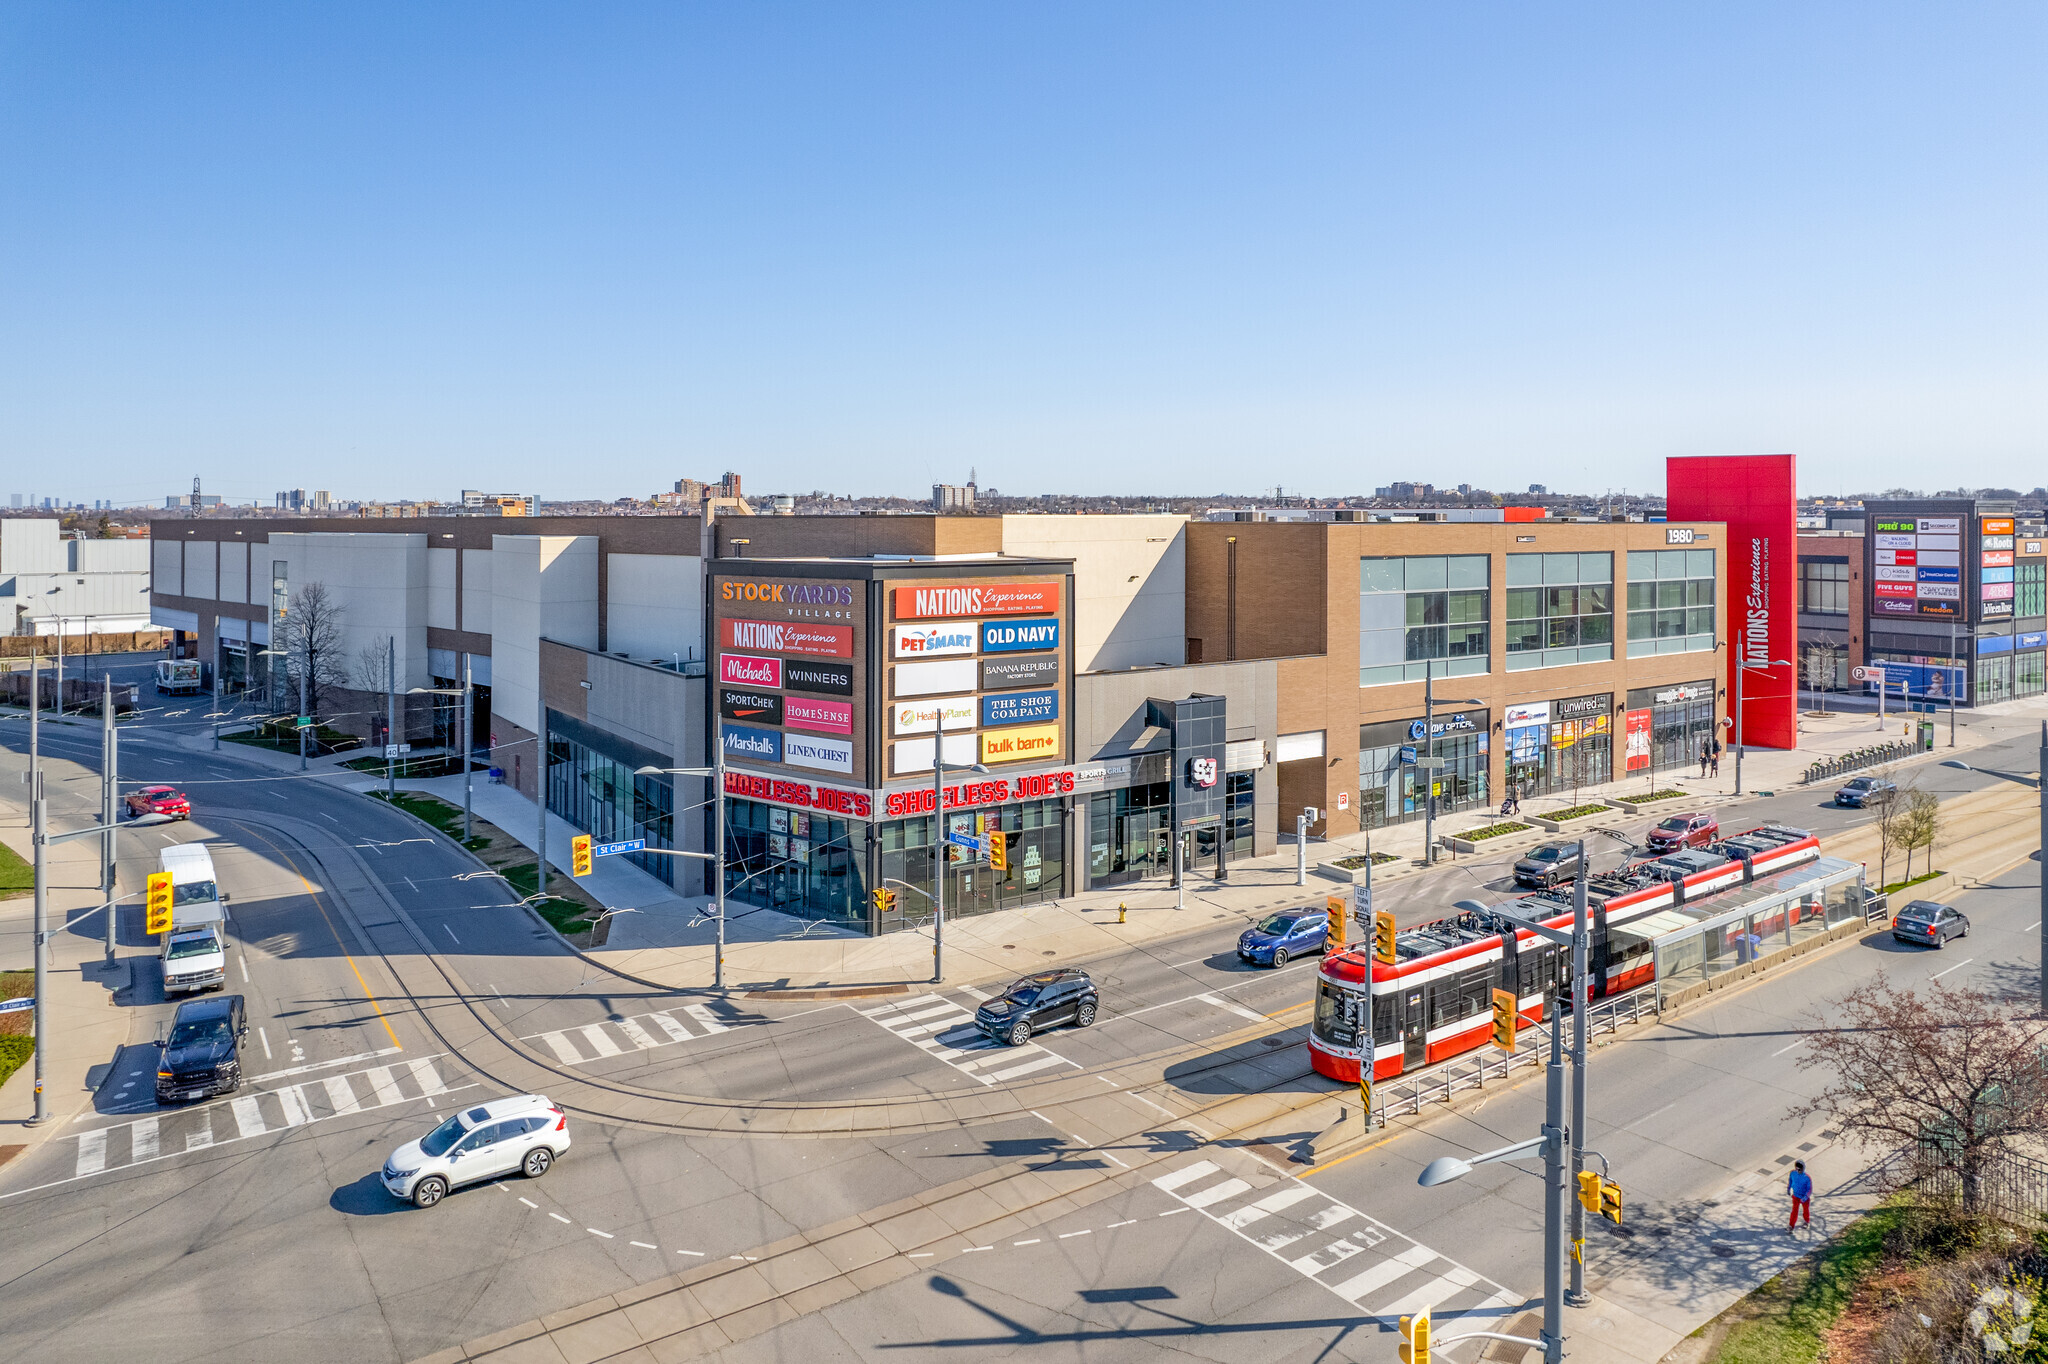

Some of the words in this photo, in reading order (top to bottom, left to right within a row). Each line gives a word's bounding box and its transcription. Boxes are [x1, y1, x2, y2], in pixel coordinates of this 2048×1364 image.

[1900, 523, 1914, 531] 90
[1668, 529, 1693, 544] 1980
[1993, 536, 2013, 549] Roots
[2026, 542, 2040, 553] 1970
[1746, 537, 1763, 609] Experience
[915, 588, 982, 616] NATIONS
[983, 588, 1044, 608] Experience
[788, 608, 851, 619] VILLAGE
[1923, 606, 1954, 614] Freedom
[733, 621, 784, 650] NATIONS
[784, 626, 838, 646] Experience
[987, 628, 1016, 644] OLD
[1018, 625, 1057, 643] NAVY
[727, 659, 773, 682] Michaels
[985, 664, 1019, 675] BANANA
[1020, 661, 1058, 672] REPUBLIC
[788, 669, 848, 686] WINNERS
[991, 699, 1017, 710] THE
[1021, 695, 1052, 707] SHOE
[1564, 696, 1597, 713] unwired
[916, 708, 972, 721] HealtyPlanet
[991, 706, 1052, 720] COMPANY
[724, 732, 774, 754] Marshalls
[987, 738, 1014, 754] bulk
[1017, 736, 1045, 751] barn
[787, 743, 817, 758] LINEN
[817, 747, 849, 763] CHEST
[1079, 767, 1107, 779] SPORTS
[1107, 766, 1127, 775] GRILL
[1012, 771, 1075, 800] JOE'S
[724, 772, 812, 807] HOELESS
[812, 786, 872, 817] JOE'S
[955, 834, 970, 845] Gunns
[601, 846, 608, 854] St
[610, 844, 627, 853] Clair
[1357, 888, 1368, 897] LEFT
[1357, 896, 1369, 905] TURN
[1355, 904, 1370, 914] SIGNAL
